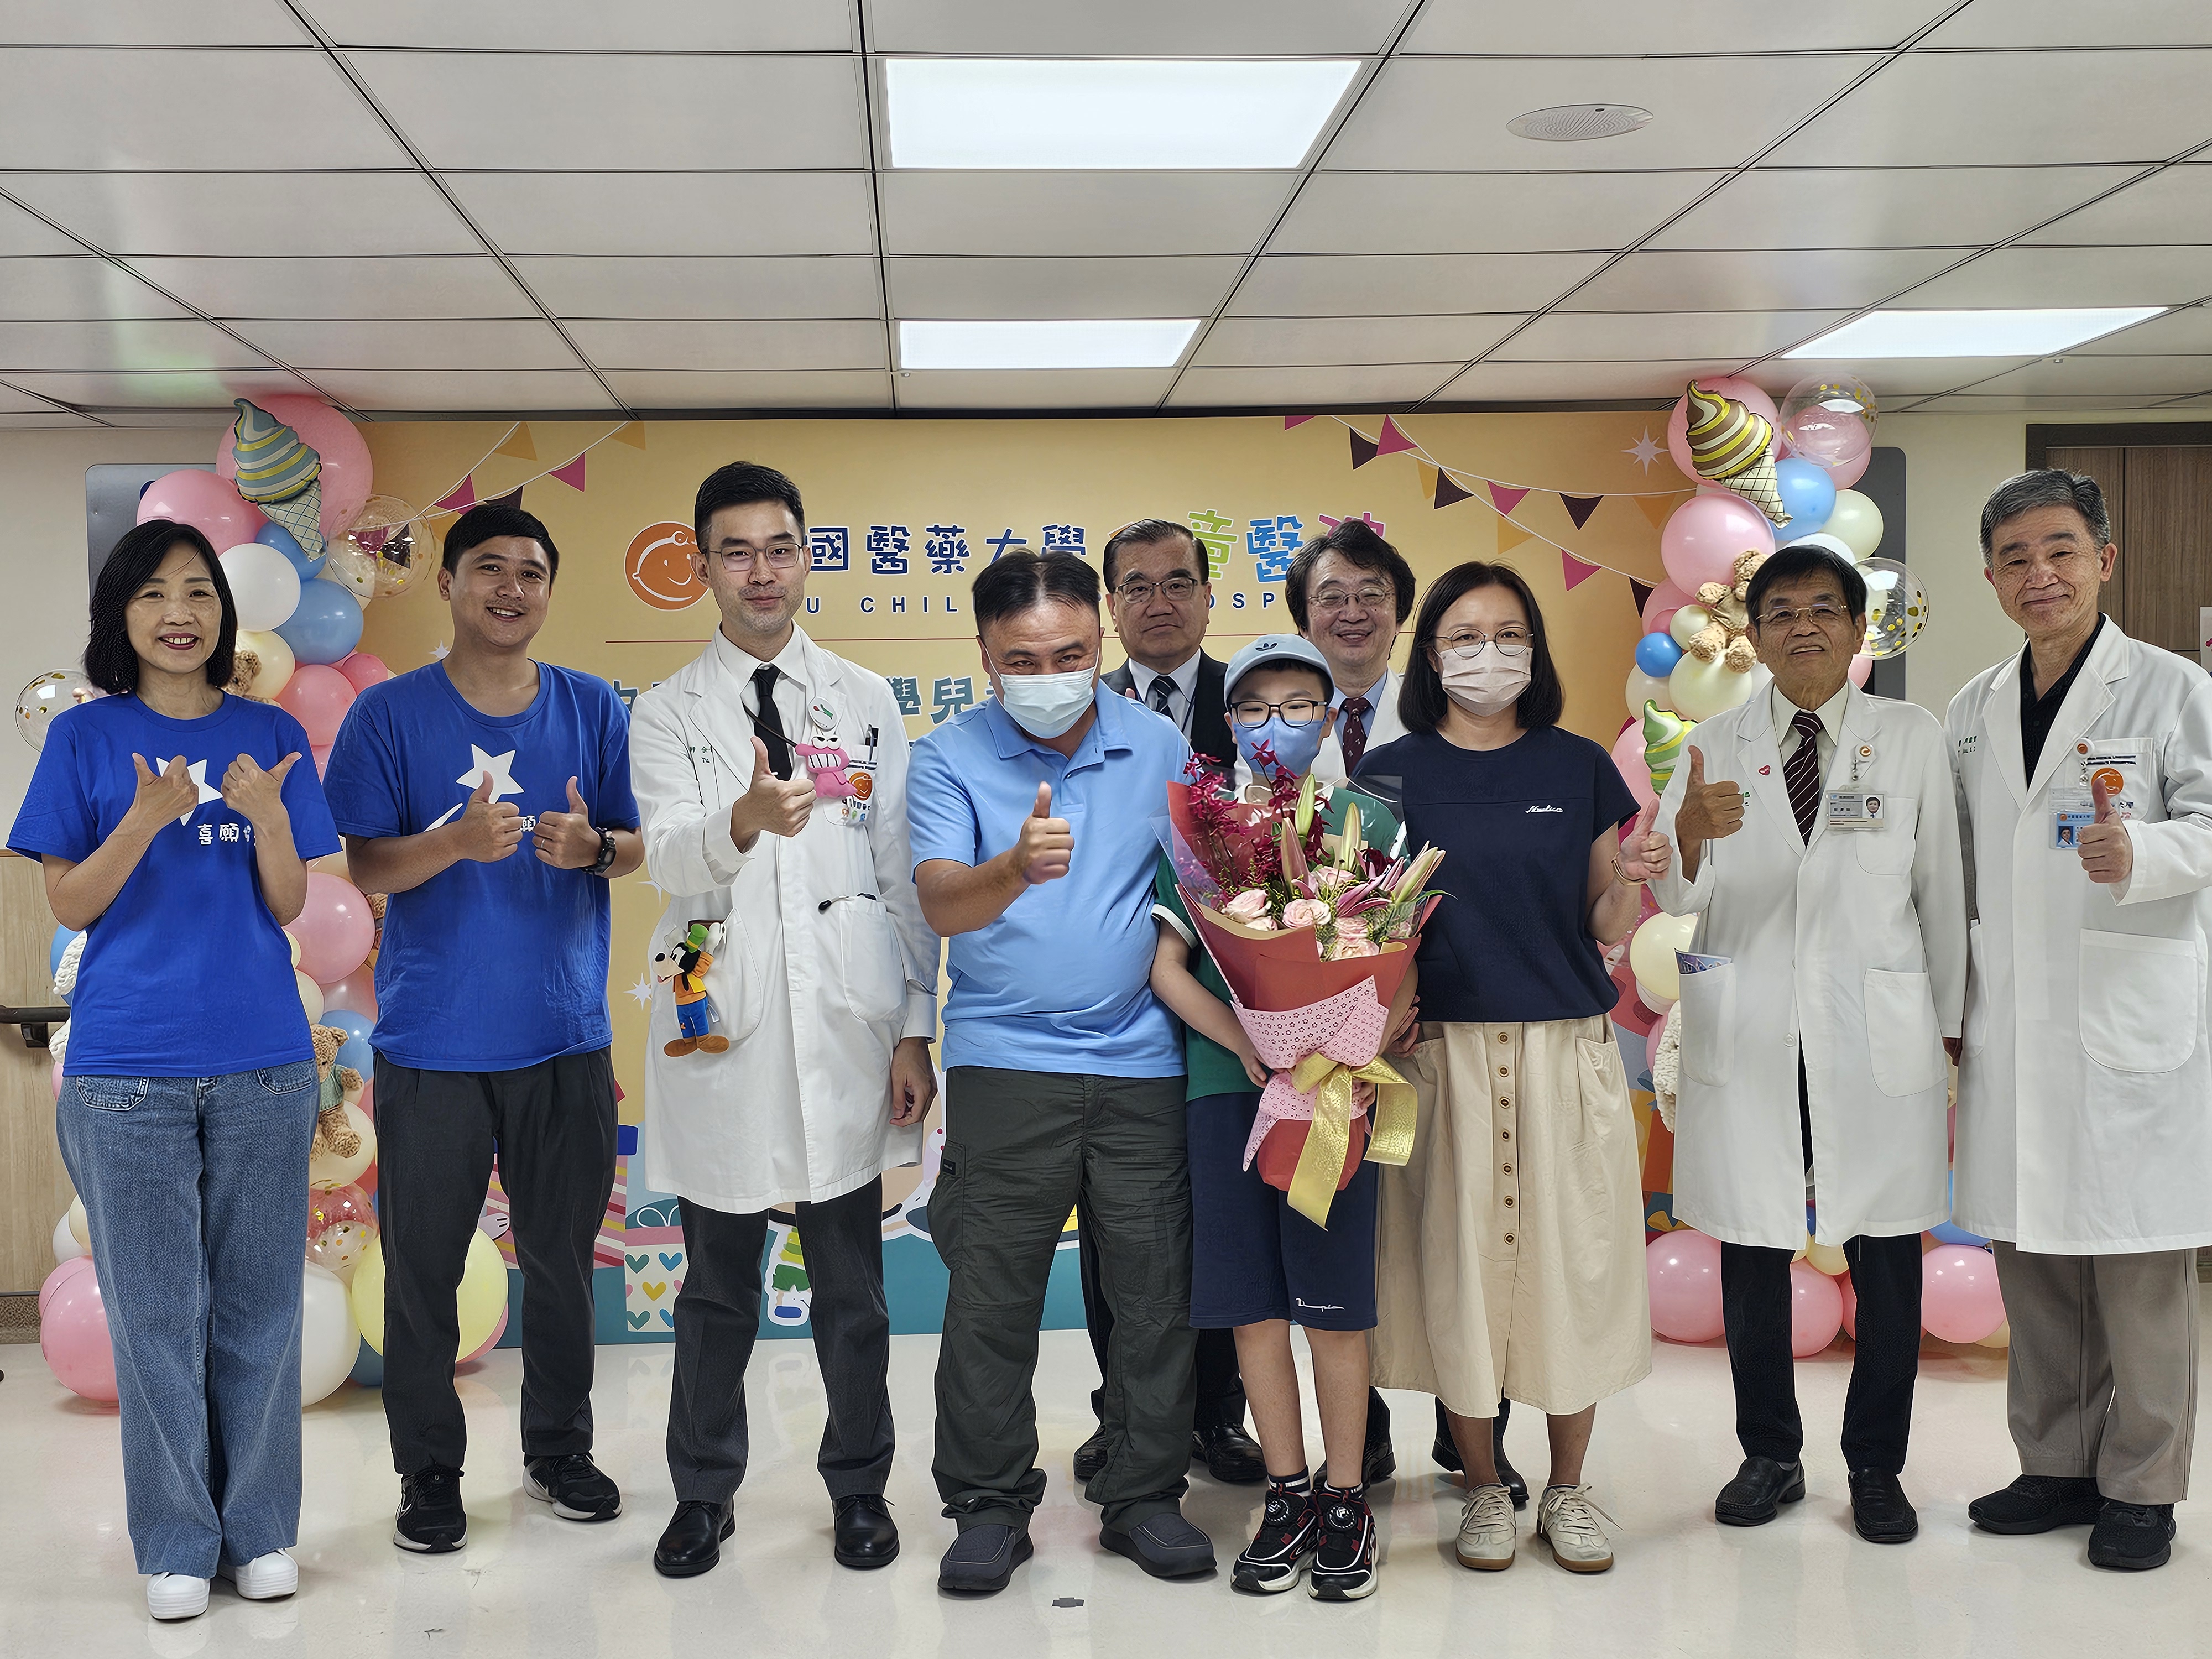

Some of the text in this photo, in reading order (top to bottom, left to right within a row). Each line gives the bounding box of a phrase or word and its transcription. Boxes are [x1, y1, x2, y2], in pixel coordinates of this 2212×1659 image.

[805, 524, 1087, 575] 國醫藥大學
